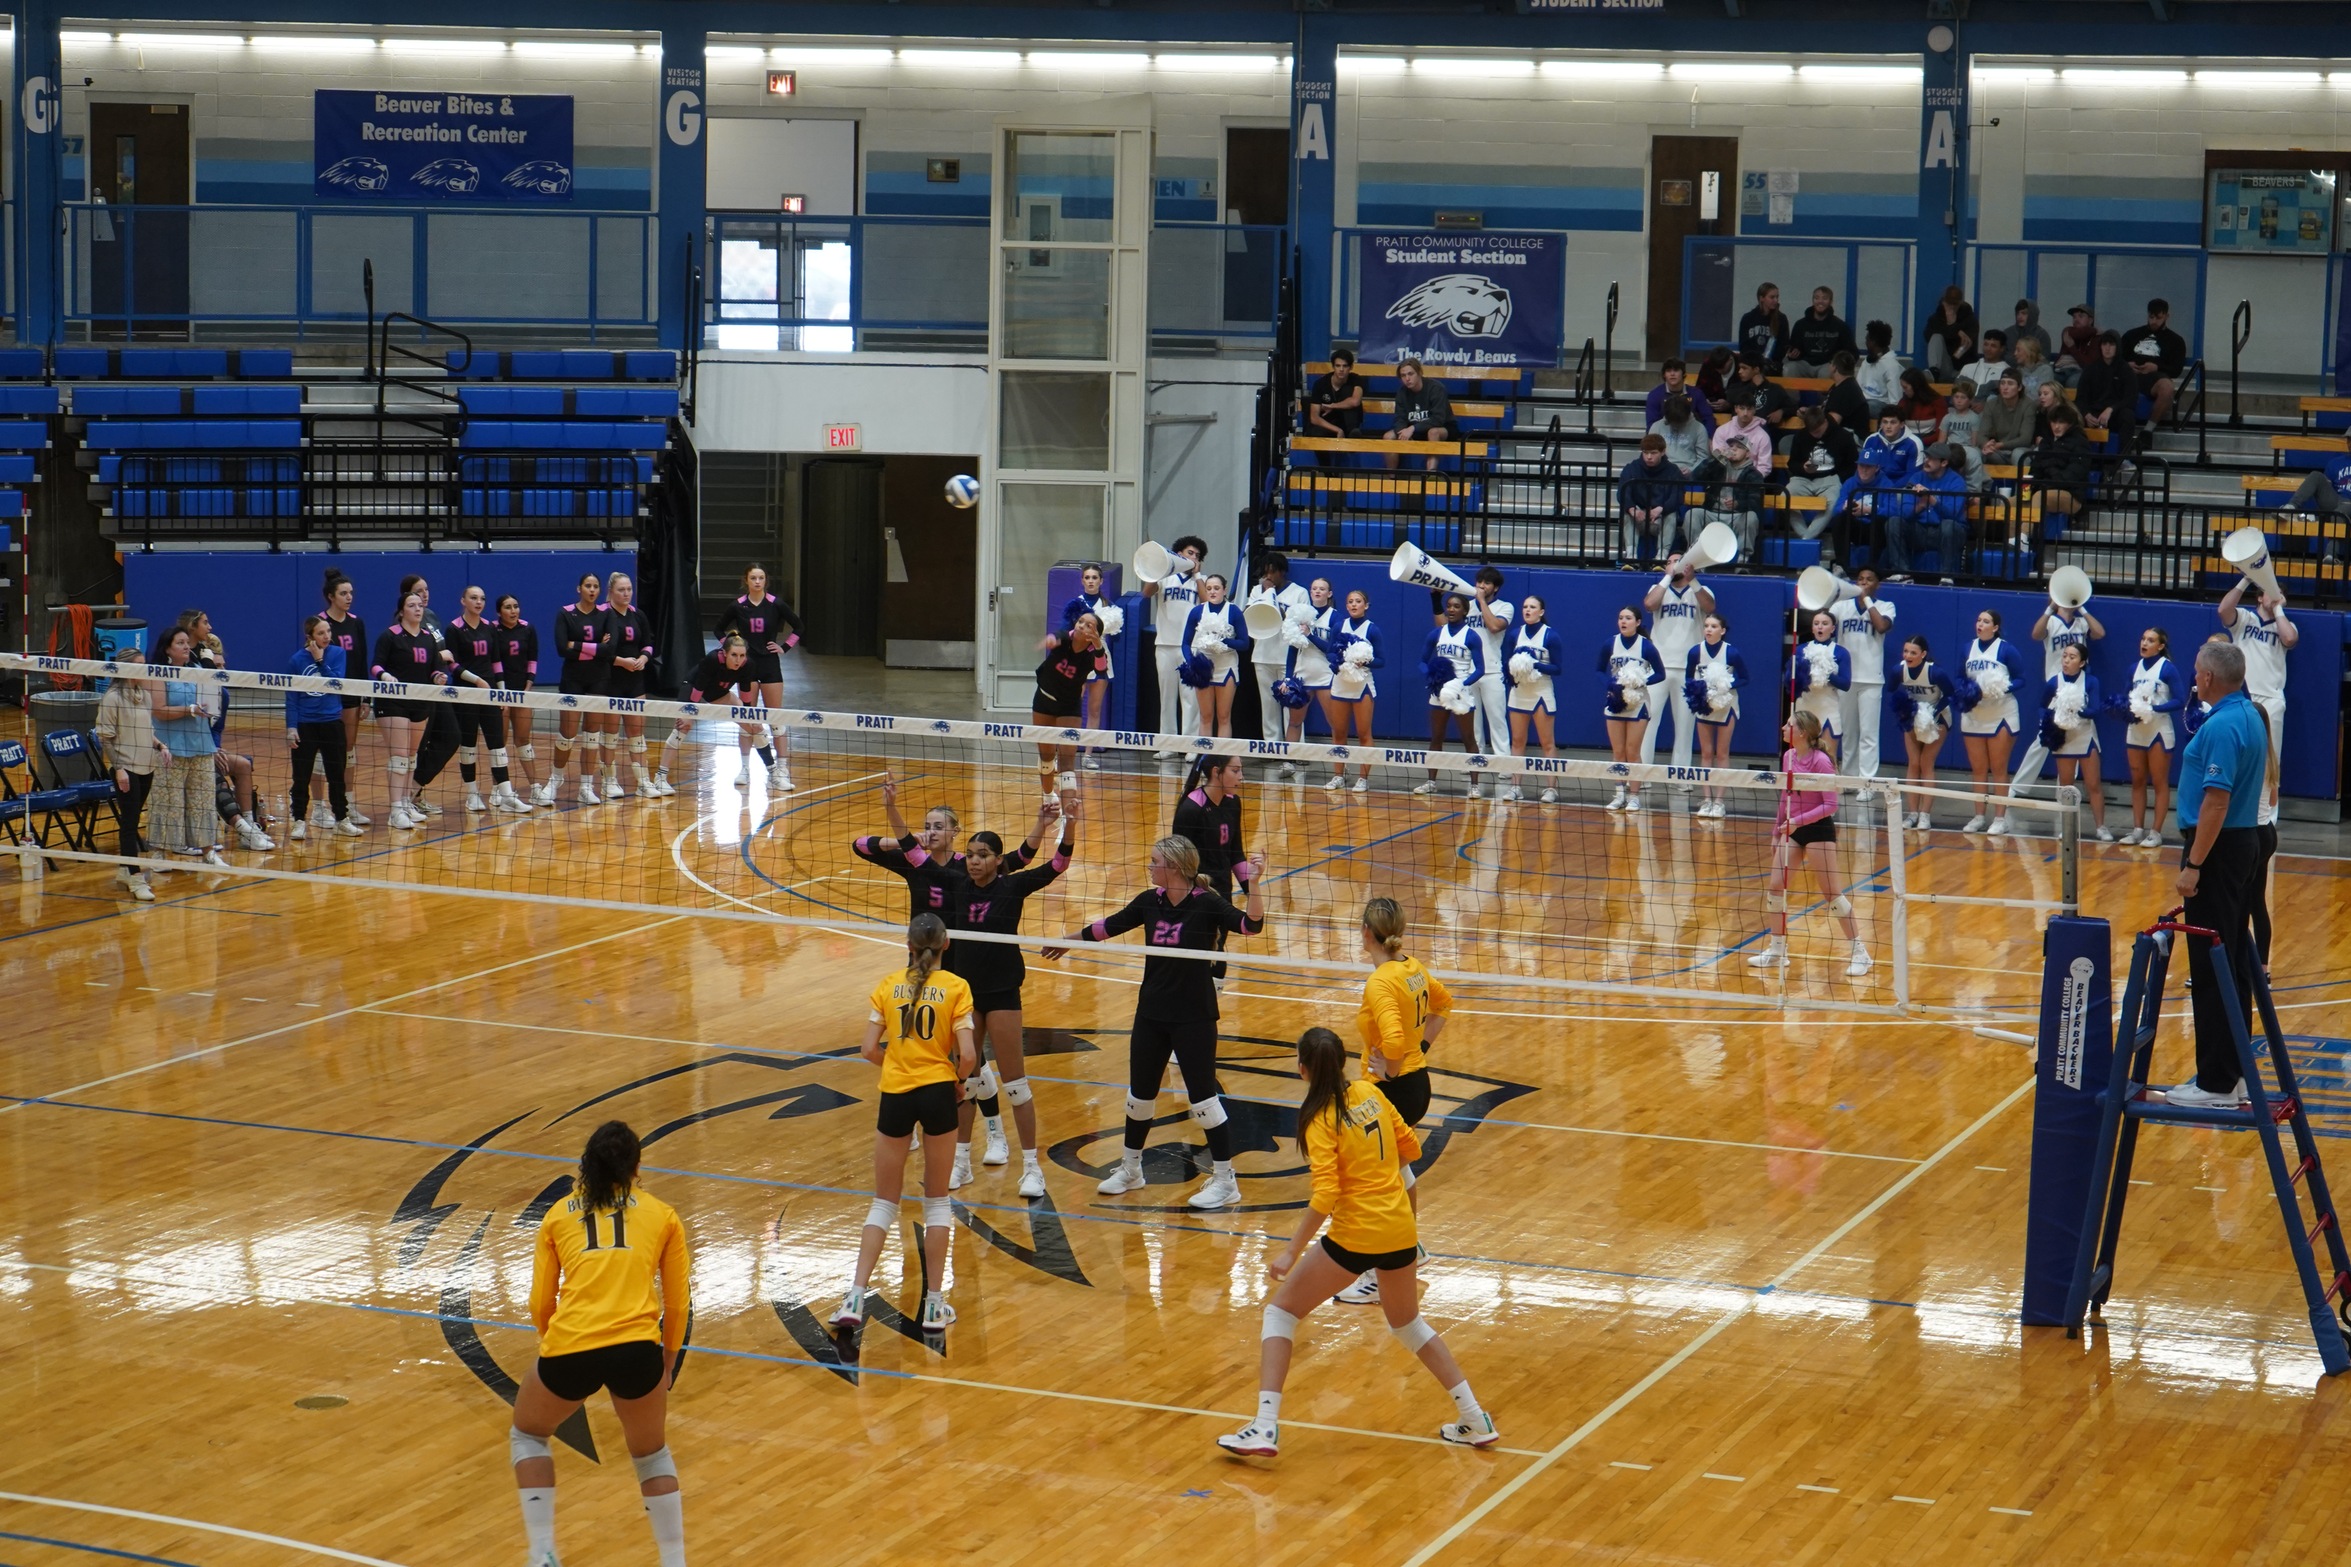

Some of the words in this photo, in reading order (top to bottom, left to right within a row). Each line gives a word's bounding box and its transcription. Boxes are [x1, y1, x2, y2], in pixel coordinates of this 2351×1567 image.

[667, 68, 701, 78] VISITOR
[666, 77, 701, 87] SEATING
[769, 74, 792, 93] EXIT
[1296, 90, 1330, 99] SECTION
[22, 76, 59, 134] G
[375, 94, 442, 114] Beaver
[447, 95, 494, 115] Bites
[499, 98, 515, 116] &
[665, 90, 701, 146] G
[362, 122, 462, 142] Recreation
[467, 124, 528, 144] Center
[1294, 103, 1329, 160] A
[1924, 110, 1960, 168] A
[1155, 180, 1186, 197] EN
[1744, 173, 1768, 189] 55
[2252, 176, 2295, 188] BEAVERS
[784, 197, 802, 212] EXIT
[1376, 237, 1409, 248] PRATT
[1412, 236, 1486, 248] COMMUNITY
[1489, 237, 1544, 249] COLLEGE
[1386, 248, 1456, 264] Student
[1460, 249, 1527, 265] Section
[1397, 348, 1421, 360] The
[1425, 348, 1471, 365] Rowdy
[1474, 349, 1517, 364] Beavs
[830, 427, 856, 447] EXIT
[1408, 568, 1460, 593] PRATT
[1163, 586, 1199, 604] PRATT
[1660, 603, 1697, 619] PRATT
[583, 625, 594, 641] 3
[625, 626, 635, 641] 9
[749, 617, 765, 633] 19
[337, 635, 353, 651] 12
[2051, 632, 2087, 651] PRATT
[2241, 625, 2280, 647] PRATT
[412, 646, 428, 663] 18
[472, 639, 488, 656] 10
[509, 640, 520, 656] 2
[1436, 644, 1468, 659] PRATT
[38, 657, 71, 671] PRATT
[147, 665, 181, 679] PRATT
[1054, 658, 1078, 680] 22
[1966, 658, 1999, 672] PRATT
[259, 673, 293, 688] PRATT
[373, 681, 408, 696] PRATT
[489, 689, 525, 704] PRATT
[609, 698, 646, 713] PRATT
[731, 706, 769, 721] PRATT
[856, 715, 895, 730] PRATT
[984, 723, 1023, 738] PRATT
[50, 734, 81, 752] PRATT
[1115, 732, 1156, 747] PRATT
[1249, 741, 1290, 756] PRATT
[1385, 749, 1427, 765] PRATT
[1525, 757, 1568, 773] PRATT
[1667, 766, 1712, 782] PRATT
[928, 885, 943, 908] 5
[968, 900, 992, 923] 17
[893, 983, 946, 1003] BUSERS
[2062, 976, 2073, 1009] COLLEGE
[1413, 989, 1430, 1029] 12
[2073, 982, 2085, 1029] BEAVER
[896, 1002, 937, 1041] 10
[2058, 1009, 2070, 1056] COMMUNITY
[2068, 1030, 2081, 1084] BACKERS
[2055, 1056, 2066, 1081] PRATT
[1363, 1118, 1385, 1161] 7
[577, 1209, 633, 1252] 11
